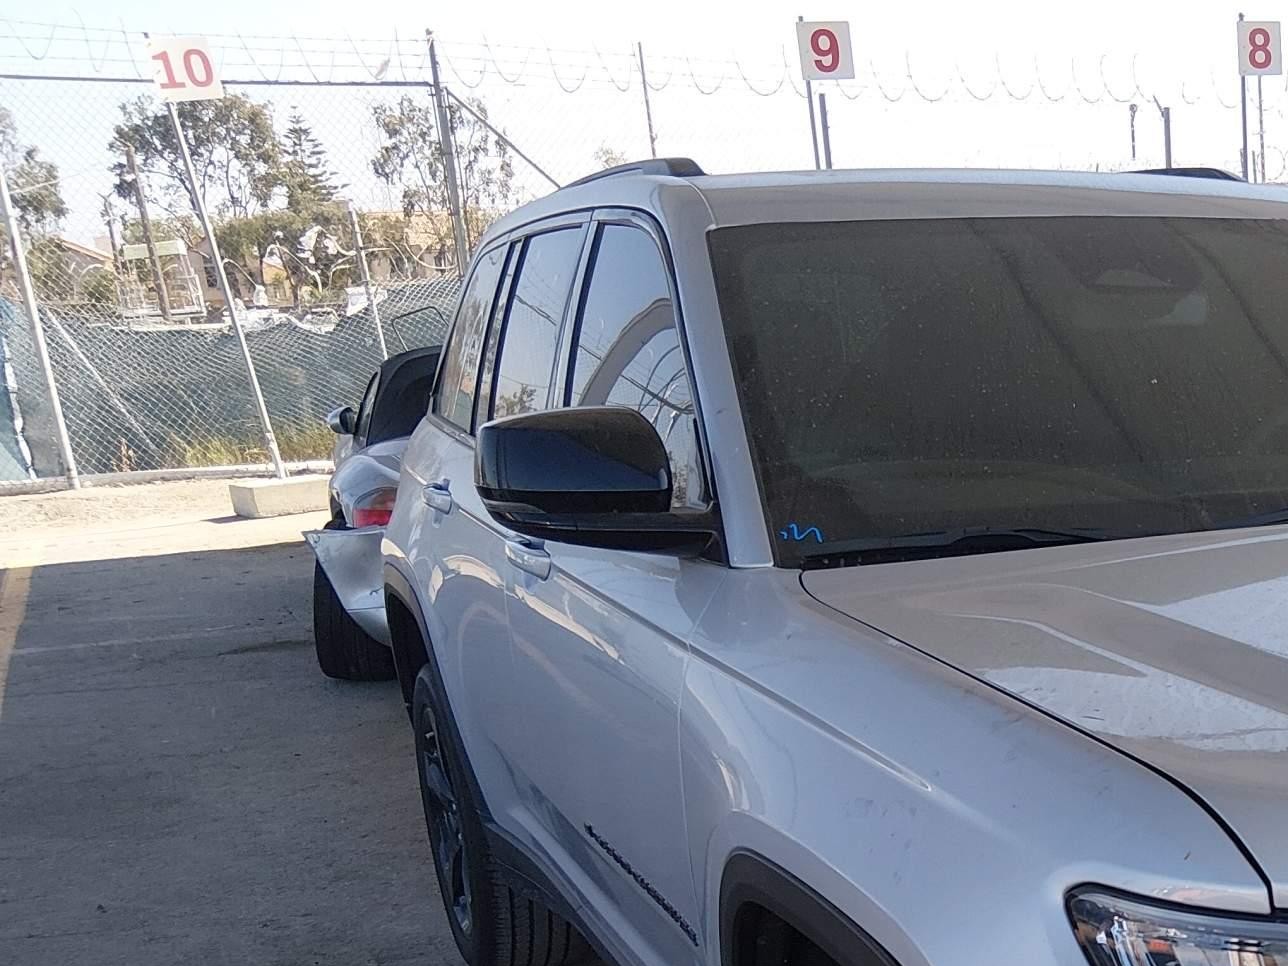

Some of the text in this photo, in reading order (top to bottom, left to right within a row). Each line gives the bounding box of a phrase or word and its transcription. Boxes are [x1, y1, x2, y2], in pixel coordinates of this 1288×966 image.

[152, 48, 213, 89] 10
[811, 28, 839, 72] 9
[1249, 28, 1271, 69] 8
